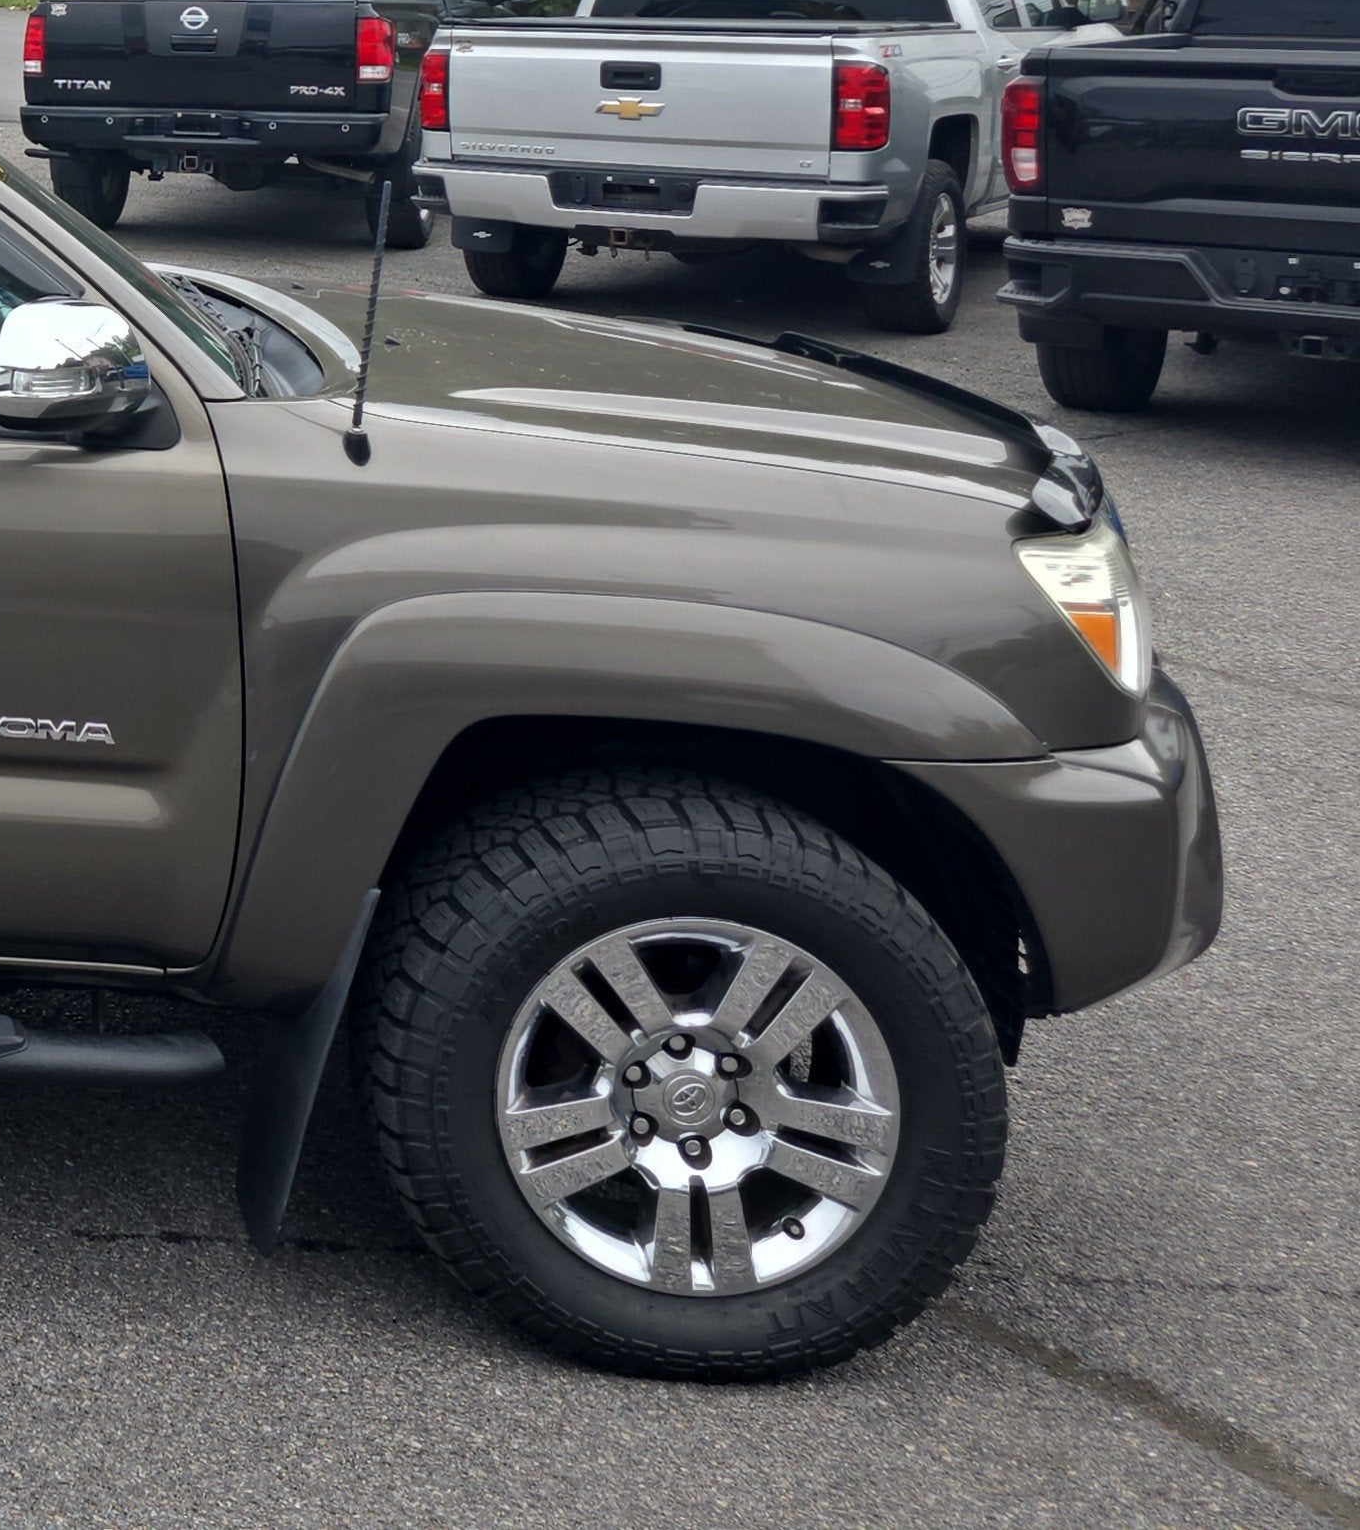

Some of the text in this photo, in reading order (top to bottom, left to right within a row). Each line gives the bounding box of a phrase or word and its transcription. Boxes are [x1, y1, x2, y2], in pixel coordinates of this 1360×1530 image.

[53, 79, 112, 90] TITAN
[290, 85, 346, 97] PRO-4X
[1237, 107, 1360, 139] GM
[460, 141, 555, 155] SILVERADO
